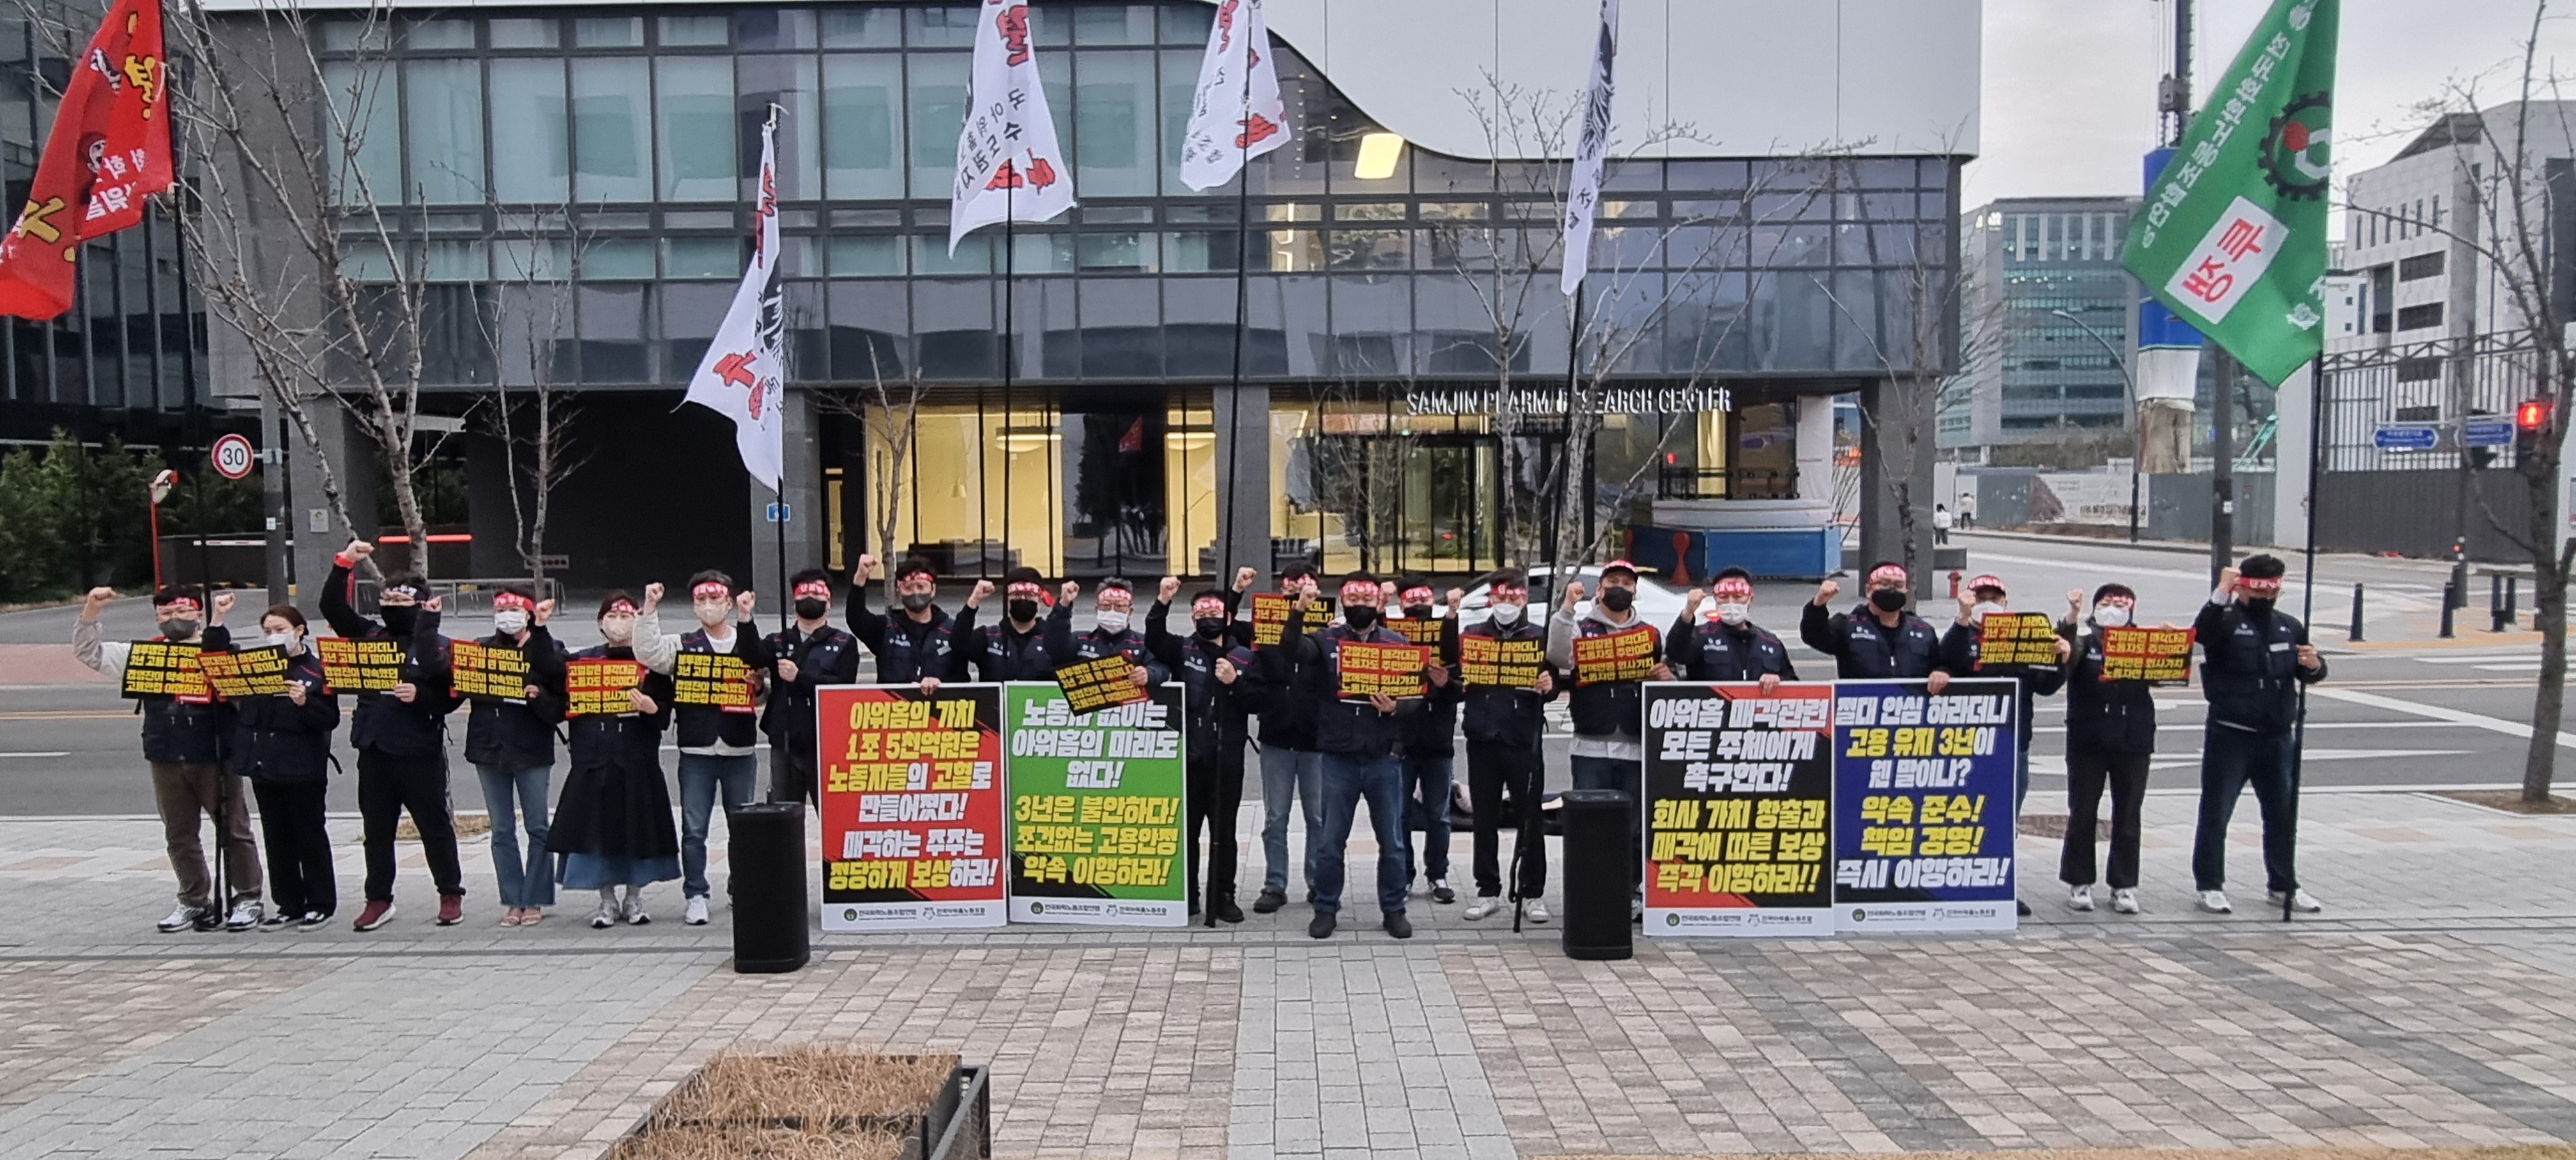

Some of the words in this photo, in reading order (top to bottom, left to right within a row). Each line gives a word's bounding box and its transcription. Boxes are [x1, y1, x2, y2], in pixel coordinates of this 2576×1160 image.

[1406, 390, 1477, 415] SAMJIN
[1557, 388, 1653, 414] RSEARCH
[1659, 386, 1731, 412] CENTER
[223, 448, 244, 466] 30
[850, 701, 930, 729] 아워홈의
[937, 699, 976, 728] 가치
[1650, 698, 1724, 728] 아워홈
[1728, 699, 1829, 728] 매각관련
[1835, 696, 1878, 725] 절대
[1880, 696, 1924, 724] 안심
[1926, 694, 2010, 724] 하라더니
[846, 733, 880, 760] 1조
[885, 731, 980, 760] 5천억원은
[1012, 729, 1104, 758] 아워홈의
[1108, 731, 1179, 758] 미래도
[1660, 731, 1712, 760] 모든
[1716, 729, 1816, 760] 주체에게
[1846, 728, 1889, 757] 고용
[1892, 727, 1935, 756] 유지
[1938, 726, 1996, 756] 3년이
[828, 763, 928, 792] 노동자들의
[932, 761, 992, 790] 고혈로
[1066, 761, 1124, 788] 없다!
[1683, 762, 1793, 792] 촉구한다!
[1867, 759, 1892, 788] 웬
[1894, 758, 1972, 788] 말이냐?
[859, 793, 969, 822] 만들어졌다!
[1015, 795, 1075, 823] 3년은
[1080, 795, 1179, 824] 불안하다!
[1652, 798, 1699, 828] 회사
[1706, 798, 1751, 828] 가치
[1755, 798, 1825, 829] 창출과
[1860, 795, 1914, 824] 약속
[1920, 794, 1986, 824] 준수!
[843, 829, 921, 859] 매각하는
[926, 828, 984, 857] 주주는
[1015, 825, 1093, 853] 조건없는
[1098, 827, 1179, 855] 고용안정
[1651, 832, 1722, 861] 매각에
[1725, 832, 1773, 861] 따른
[1777, 832, 1826, 861] 보상
[1860, 827, 1915, 856] 책임
[1919, 826, 1985, 855] 경영!
[829, 860, 908, 890] 정당하게
[911, 859, 999, 887] 보상하라!
[1023, 856, 1067, 883] 약속
[1073, 857, 1172, 885] 이행하라!
[1657, 864, 1704, 893] 즉각
[1708, 863, 1821, 893] 이행하라!!
[1836, 859, 1889, 889] 즉시
[1894, 858, 2011, 888] 이행하라!
